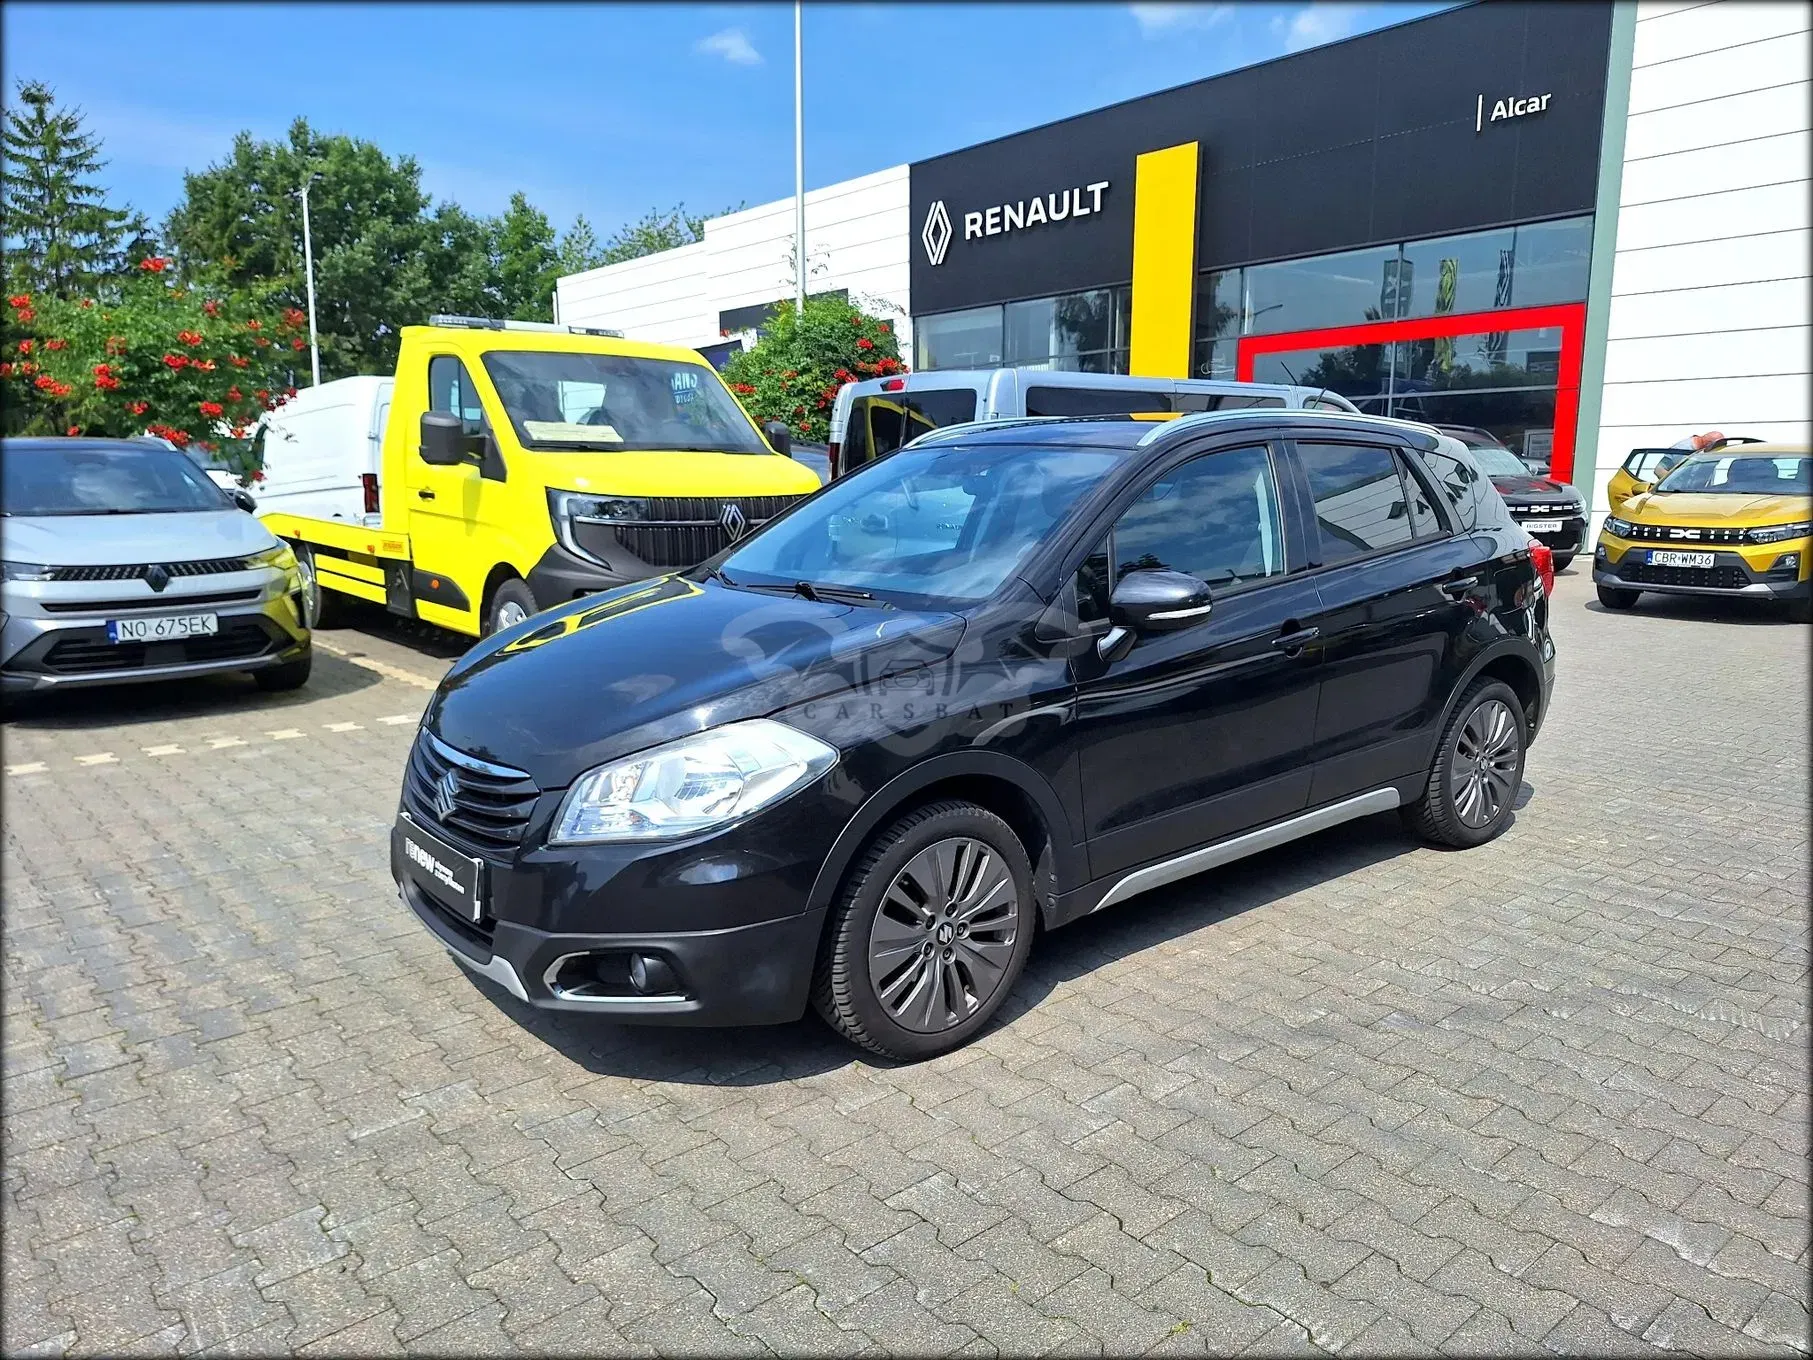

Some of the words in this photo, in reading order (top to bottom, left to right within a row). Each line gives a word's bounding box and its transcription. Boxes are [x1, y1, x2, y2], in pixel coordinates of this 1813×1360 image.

[1490, 93, 1552, 122] Alcar
[964, 181, 1109, 240] RENAULT
[1654, 552, 1678, 563] CBR
[1681, 553, 1711, 565] WM36
[121, 621, 147, 637] NO
[155, 617, 212, 635] 675EK
